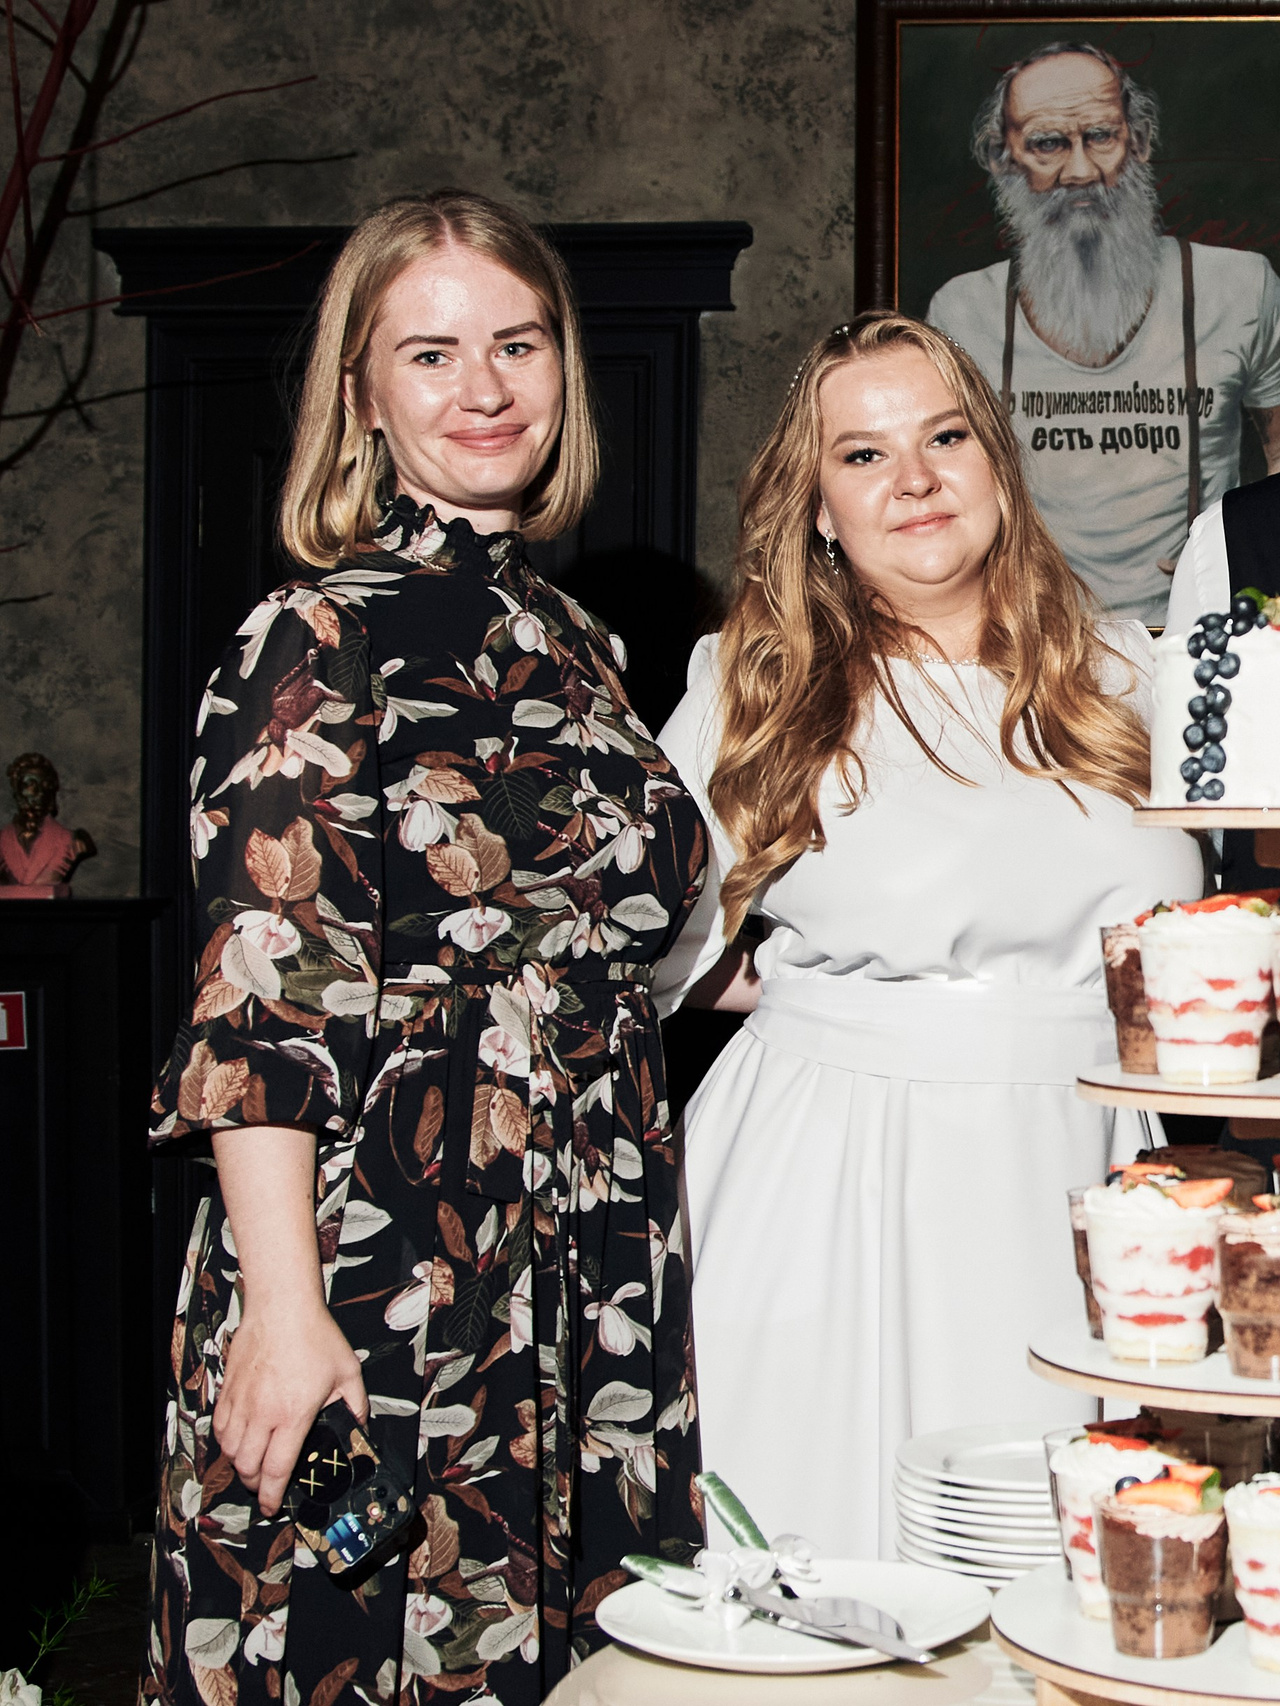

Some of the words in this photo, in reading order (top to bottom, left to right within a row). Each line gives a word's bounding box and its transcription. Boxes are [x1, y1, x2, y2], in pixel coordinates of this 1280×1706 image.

[1022, 390, 1044, 418] что
[1045, 390, 1112, 419] умножает
[1113, 380, 1164, 414] любовь
[1167, 387, 1175, 415] в
[1177, 386, 1214, 418] мре
[1031, 426, 1094, 452] есть
[1099, 422, 1181, 455] добро
